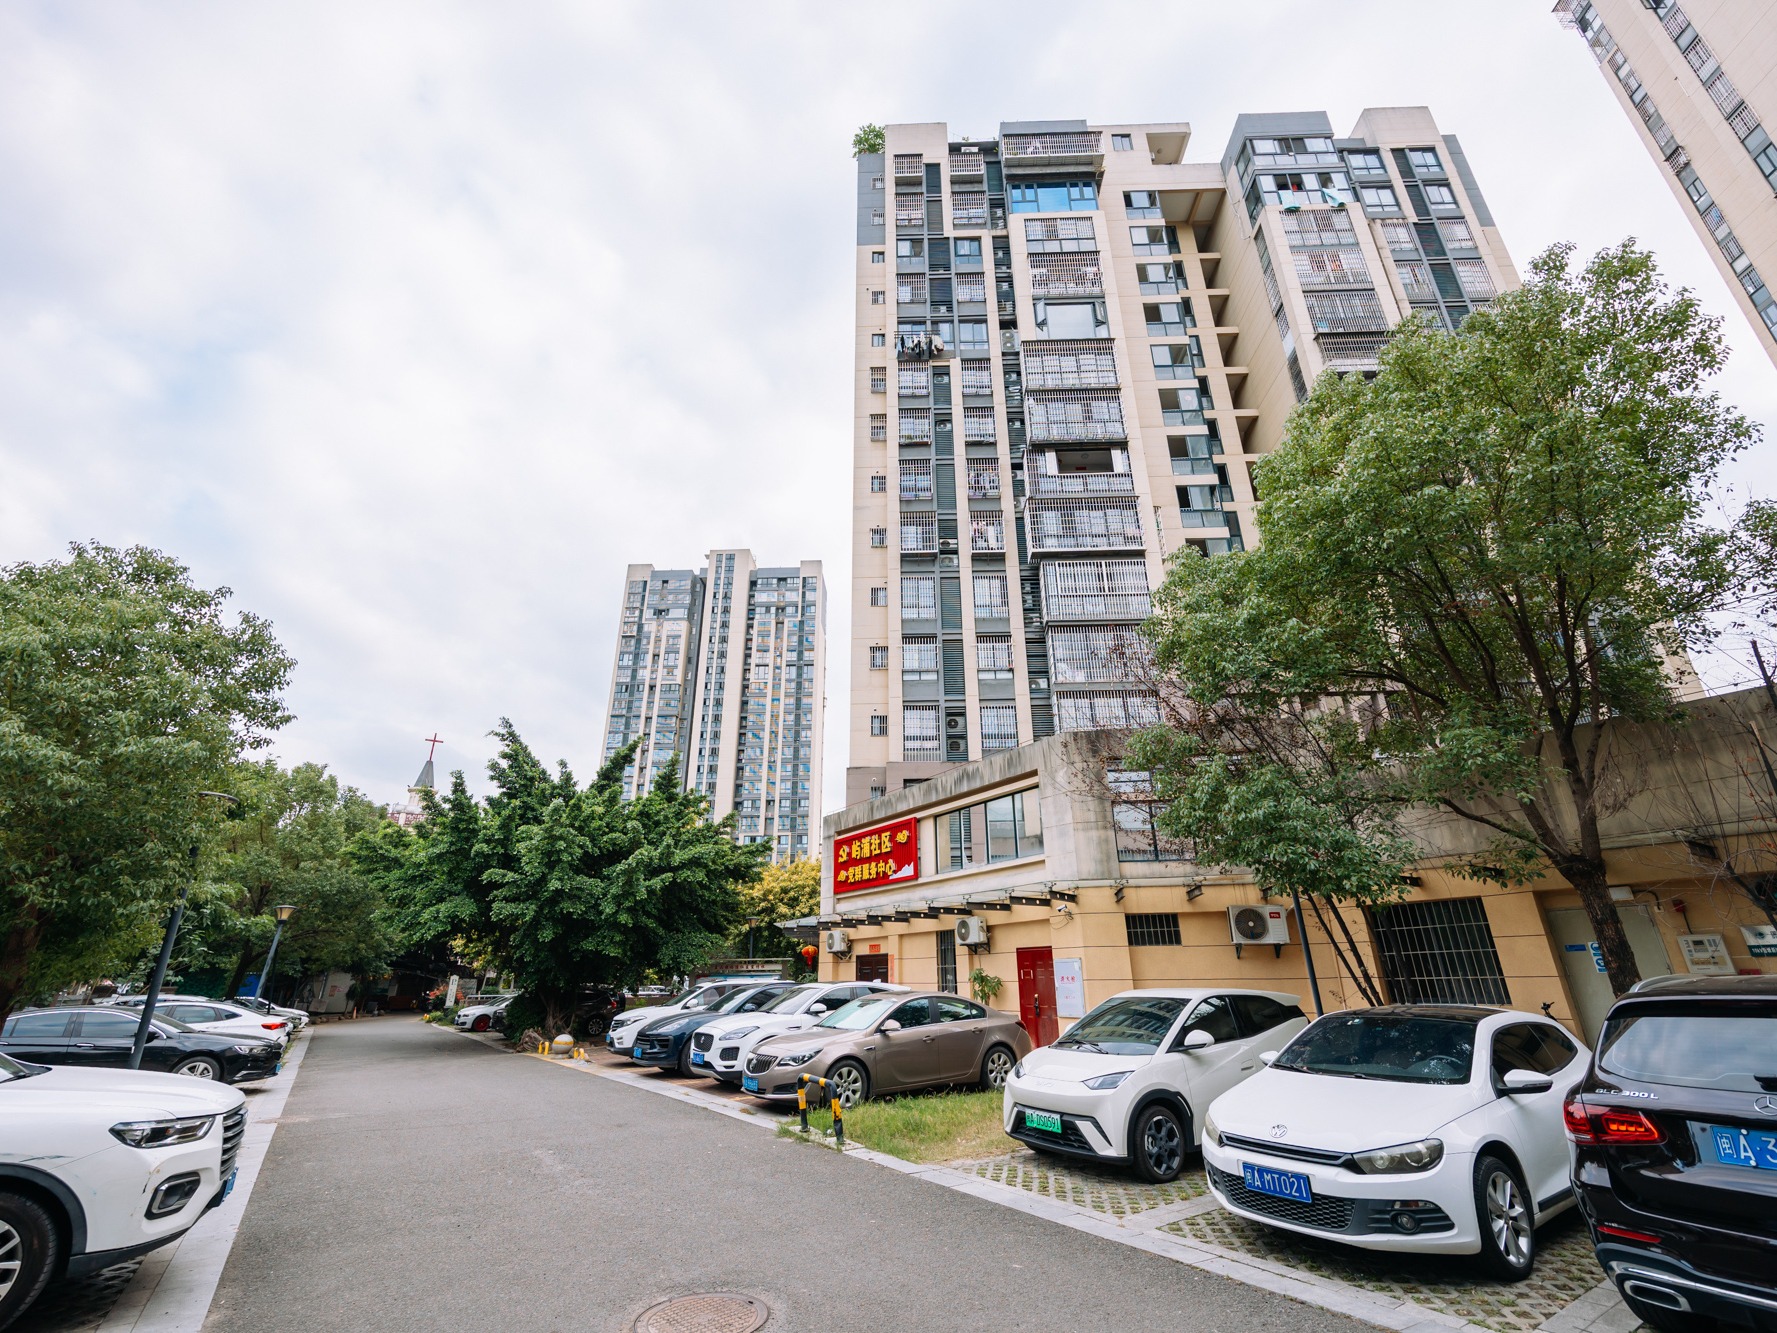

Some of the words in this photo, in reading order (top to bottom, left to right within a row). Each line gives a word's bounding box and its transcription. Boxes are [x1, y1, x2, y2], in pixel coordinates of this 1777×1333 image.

[851, 831, 892, 859] 屿浦社区
[848, 859, 896, 884] 党群服务中心
[1621, 1090, 1649, 1098] 300
